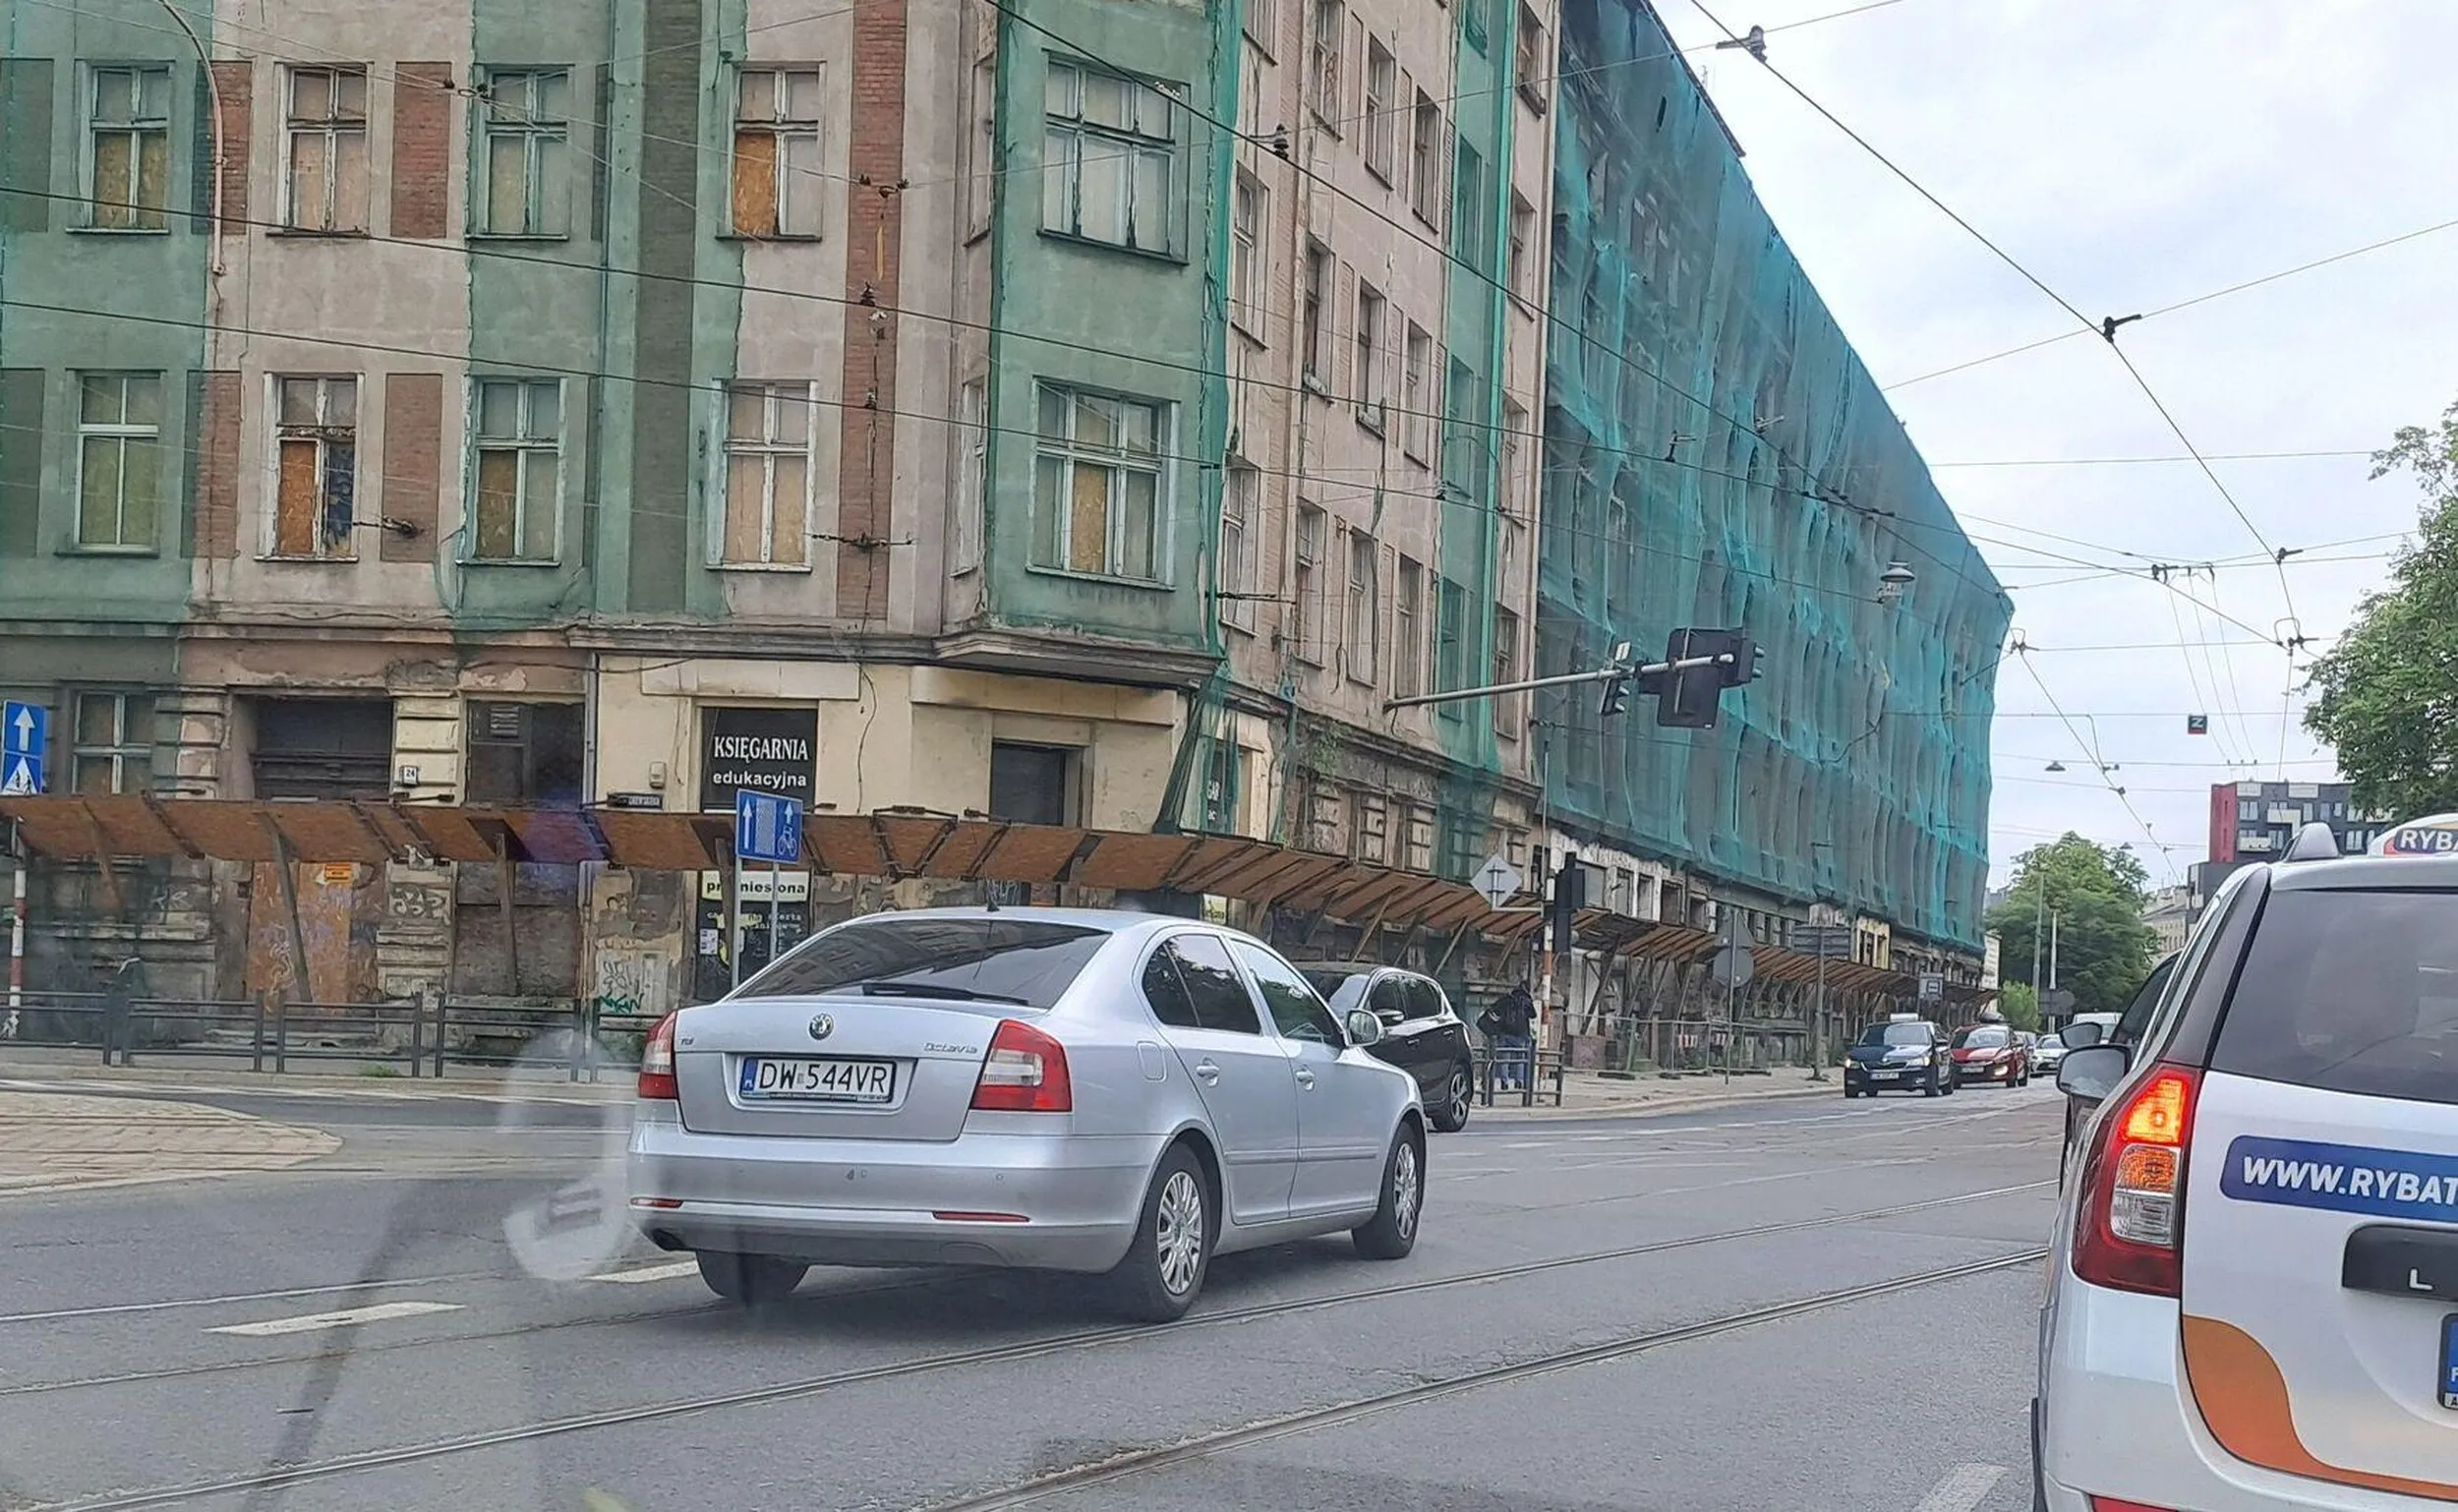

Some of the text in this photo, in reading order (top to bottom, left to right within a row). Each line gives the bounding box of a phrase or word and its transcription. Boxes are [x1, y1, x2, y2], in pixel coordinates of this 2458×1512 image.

[714, 736, 808, 763] KSIĘGARNIA
[713, 770, 807, 789] edukacyjna
[759, 1062, 887, 1093] DW 544VR
